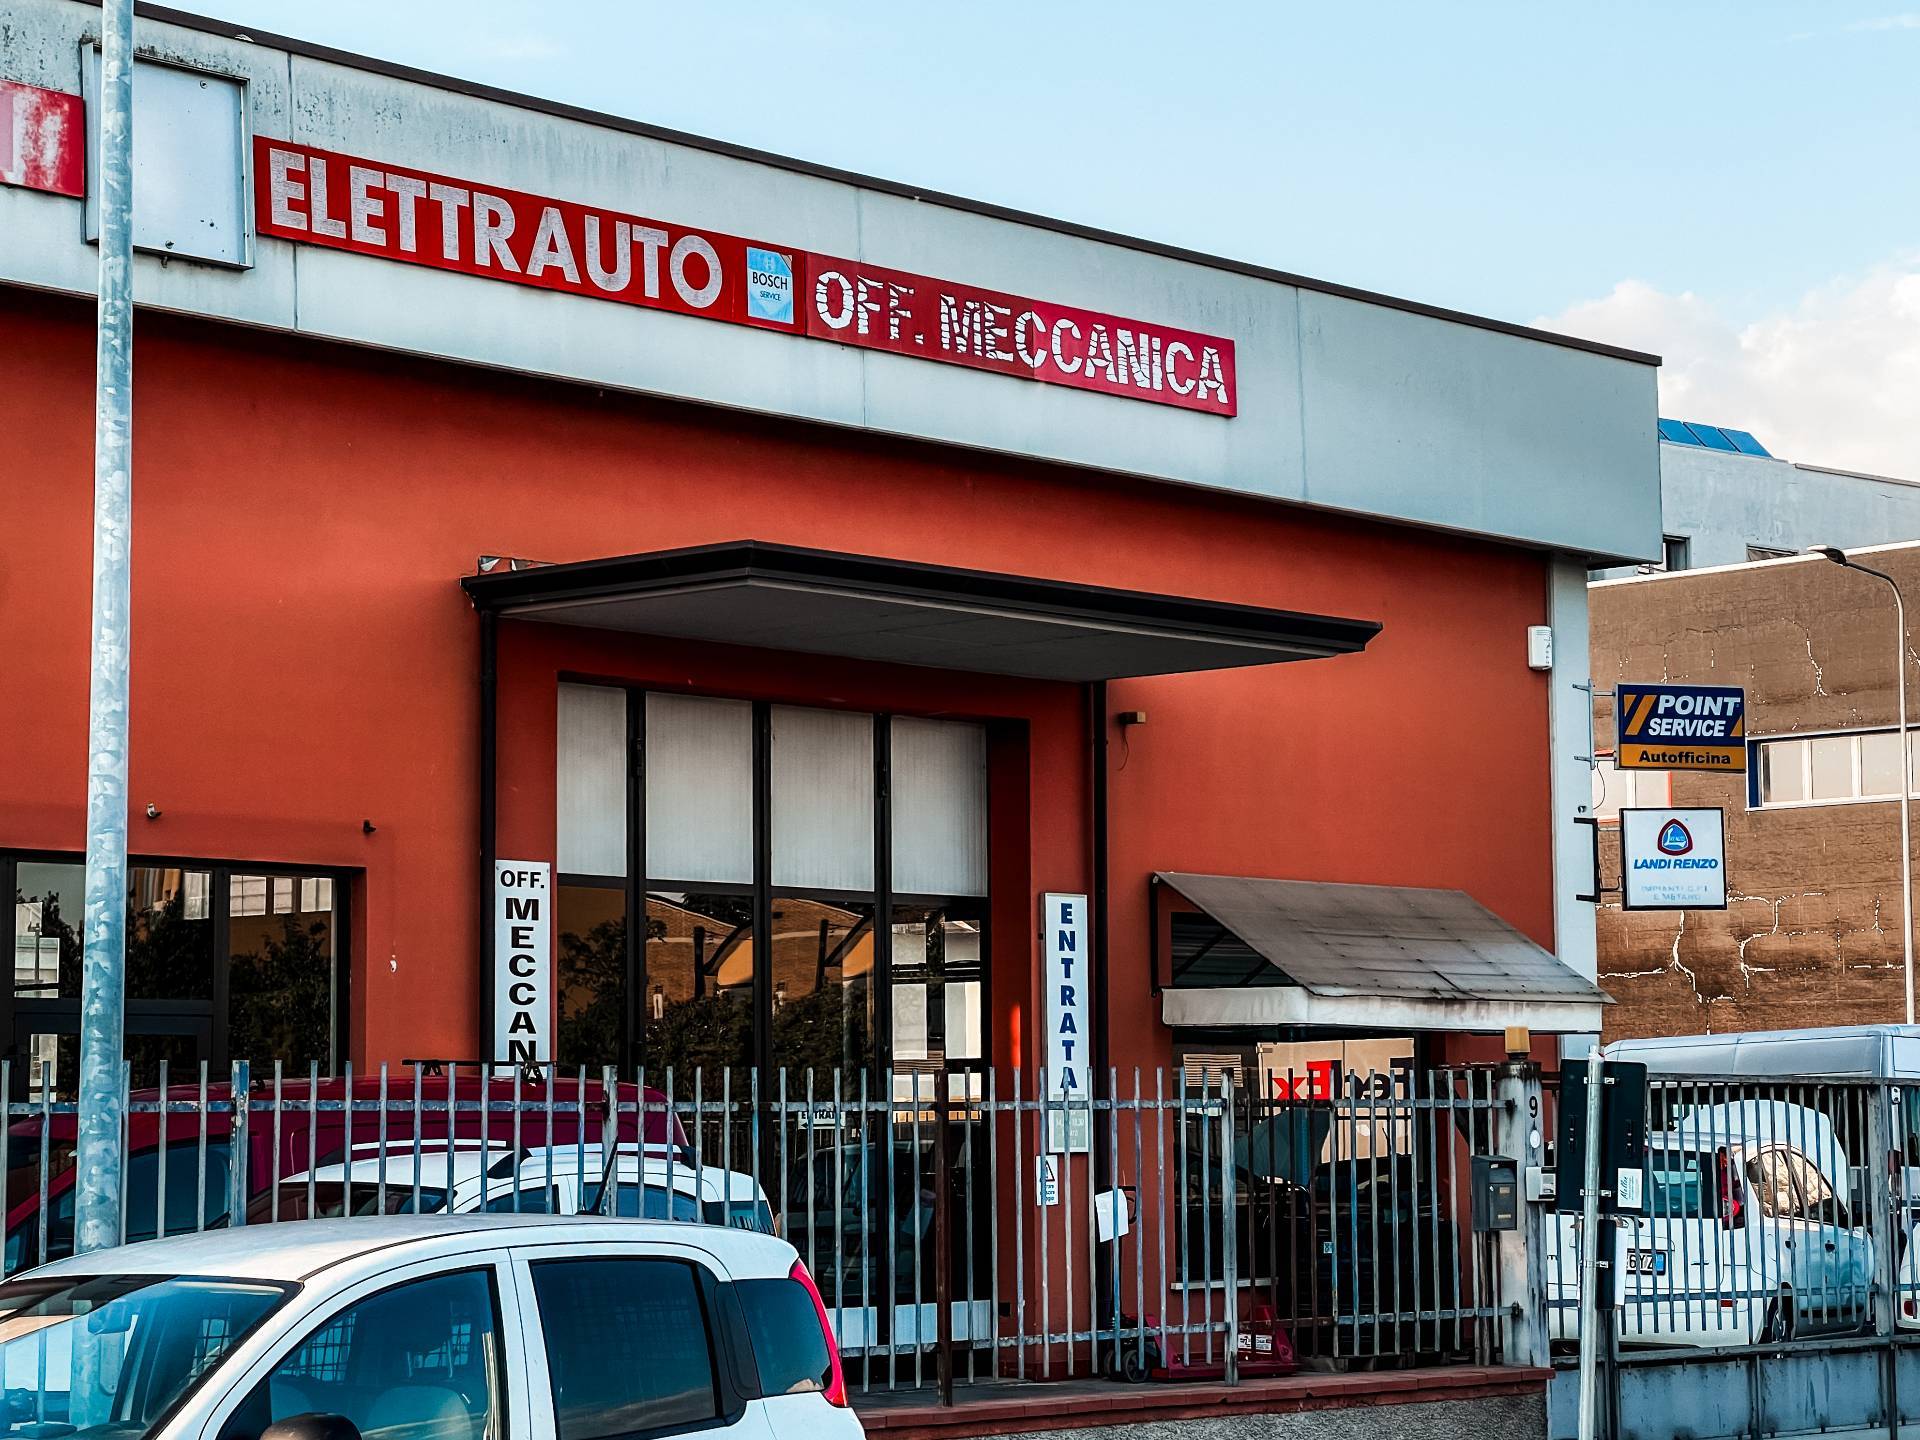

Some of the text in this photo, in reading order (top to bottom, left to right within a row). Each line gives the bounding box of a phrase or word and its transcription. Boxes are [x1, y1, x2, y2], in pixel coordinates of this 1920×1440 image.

[270, 148, 724, 310] ELETTRAUTO
[752, 271, 788, 290] BOSCH
[760, 290, 781, 301] SERVICE
[815, 271, 1229, 404] OFF. MECCANICA
[1657, 695, 1741, 716] POINT
[1648, 717, 1726, 737] SERVICE
[1639, 751, 1731, 765] Autofficina
[1633, 858, 1719, 870] LANDI RENZO
[500, 870, 545, 889] OFF.
[1529, 1095, 1538, 1119] 9
